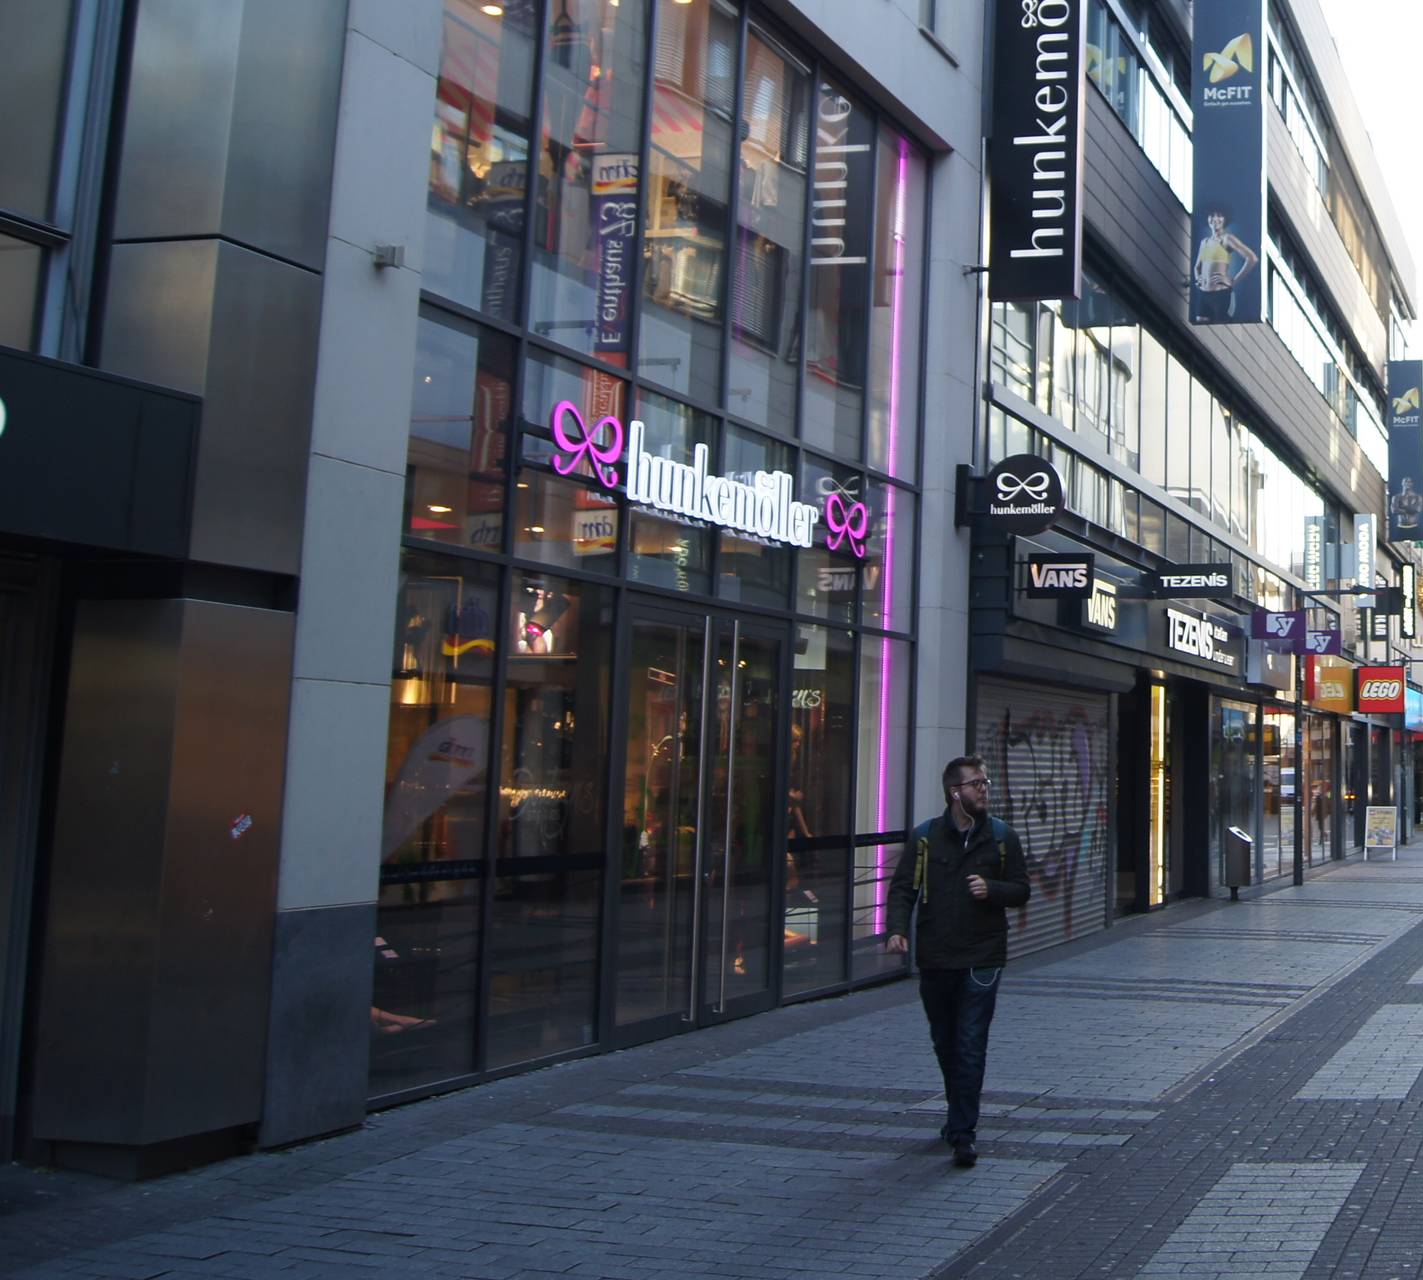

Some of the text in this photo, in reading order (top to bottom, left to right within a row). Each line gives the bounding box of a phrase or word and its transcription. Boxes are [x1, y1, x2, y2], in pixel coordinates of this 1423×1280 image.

[1203, 86, 1252, 100] McFIT
[1393, 416, 1419, 425] McFIT
[626, 419, 818, 549] hunkemöller
[990, 503, 1056, 515] hunkemöller
[1031, 563, 1088, 589] VANS
[1160, 574, 1229, 588] TEZENIS
[1087, 579, 1117, 630] VANS
[1167, 608, 1213, 660] TEZENIS
[1361, 680, 1401, 698] LEGO
